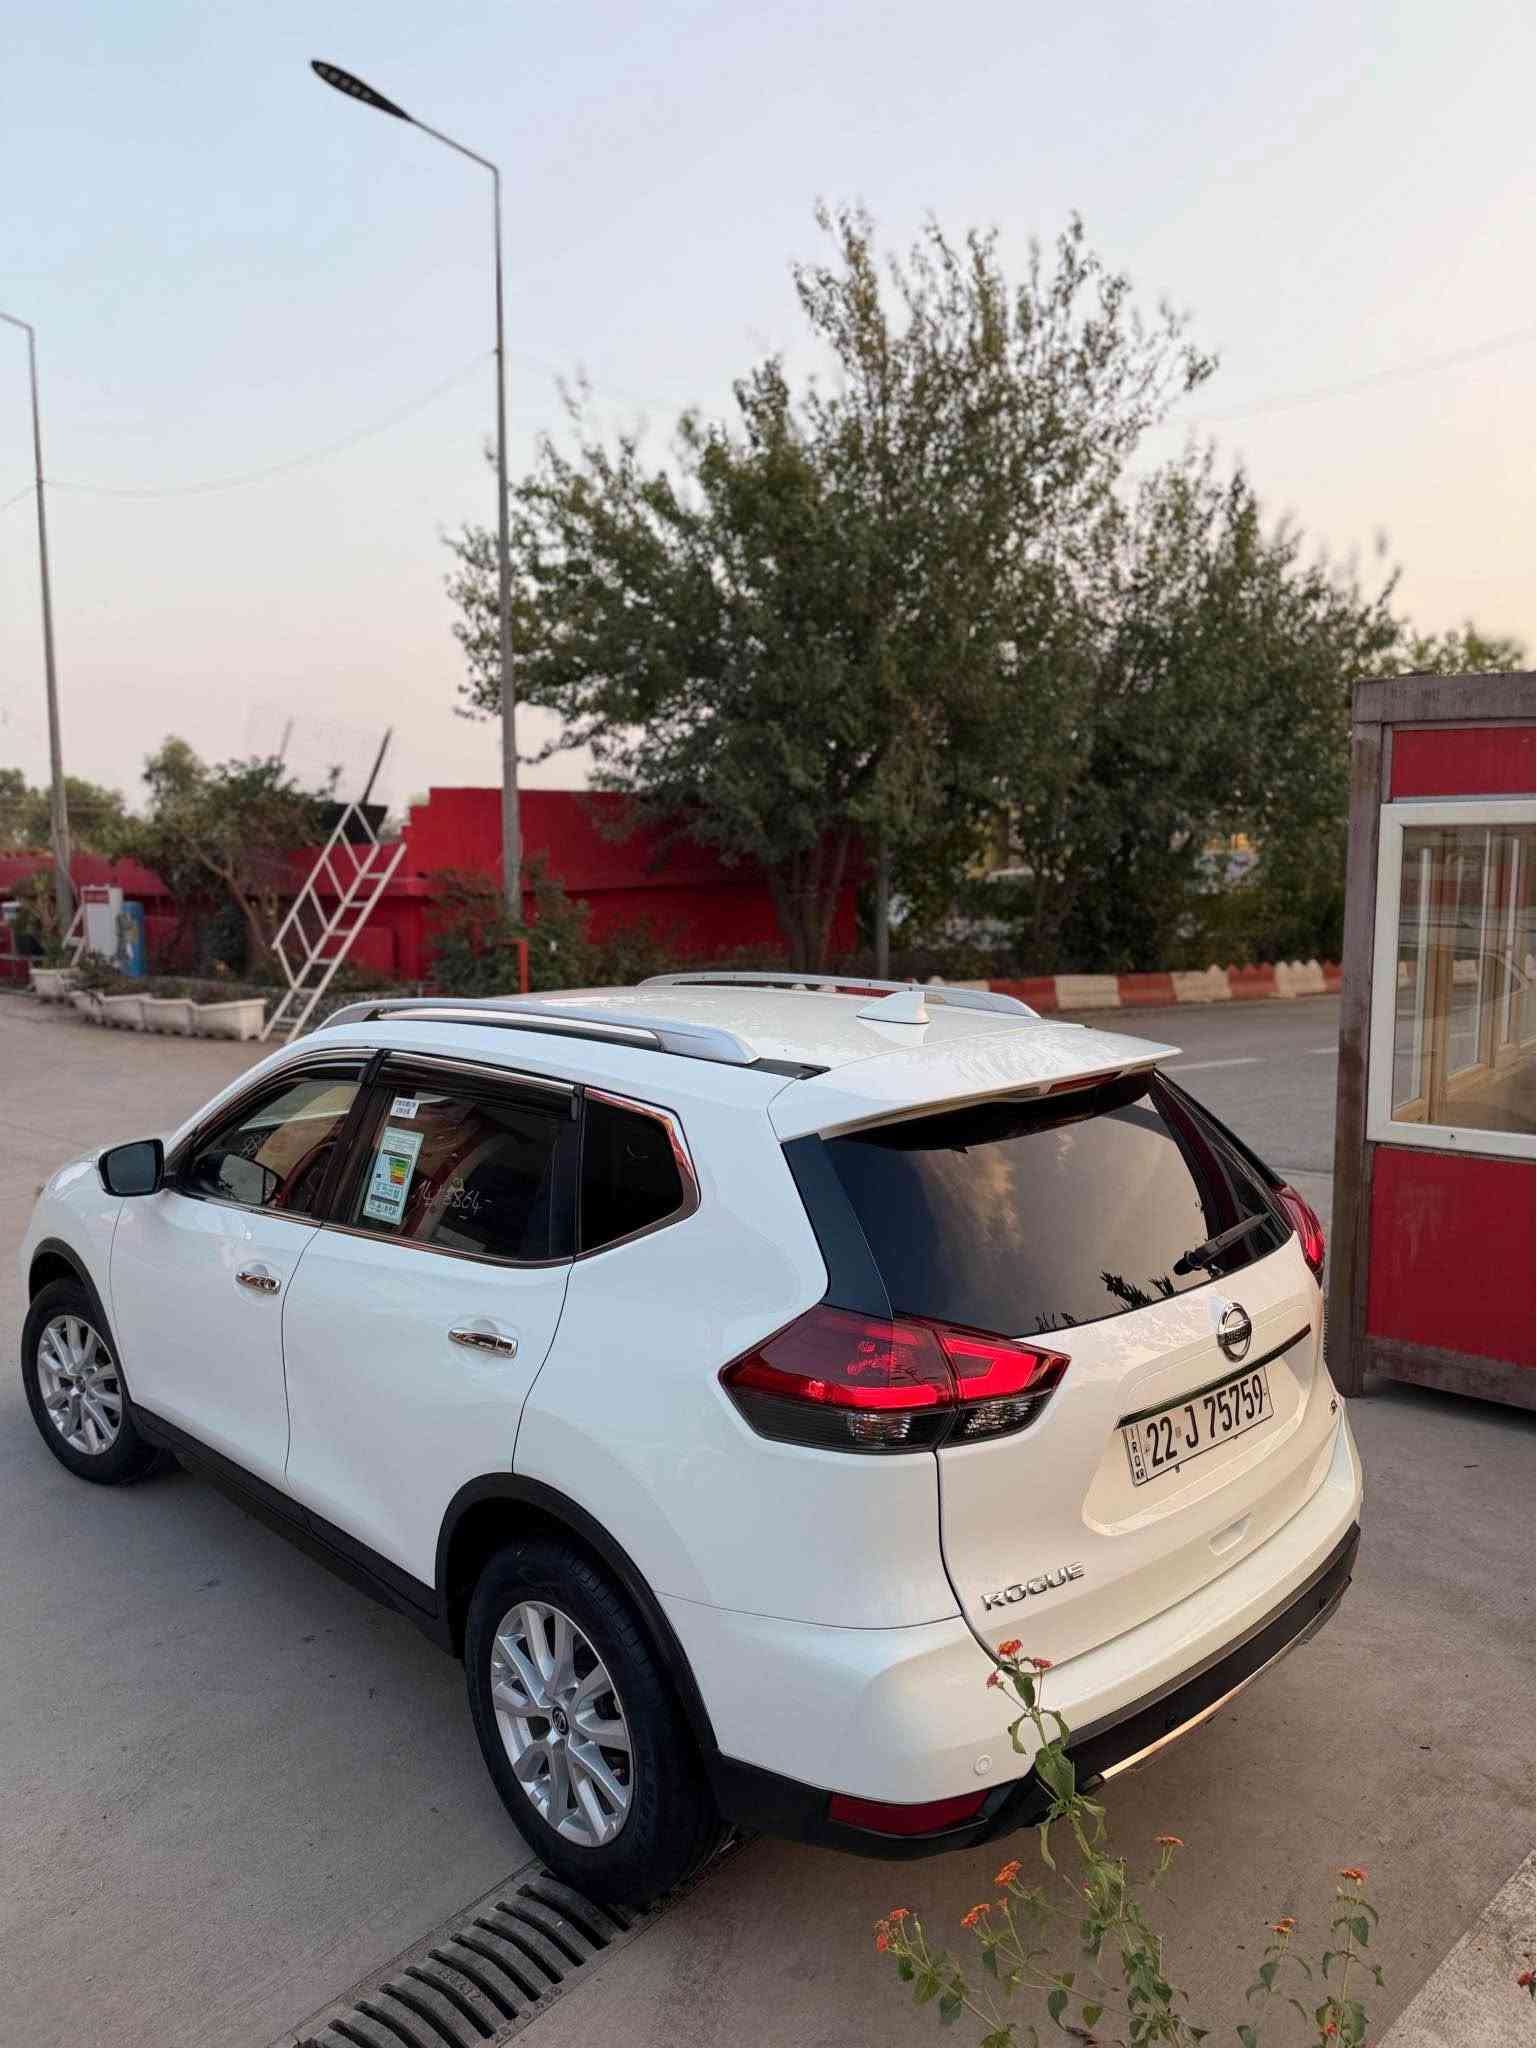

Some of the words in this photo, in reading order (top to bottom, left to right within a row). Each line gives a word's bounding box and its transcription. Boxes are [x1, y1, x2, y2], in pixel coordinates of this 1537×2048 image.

[1146, 1416, 1177, 1467] 22
[1184, 1405, 1199, 1448] J
[1203, 1374, 1263, 1438] 75759
[981, 1561, 1085, 1610] ROGUE
